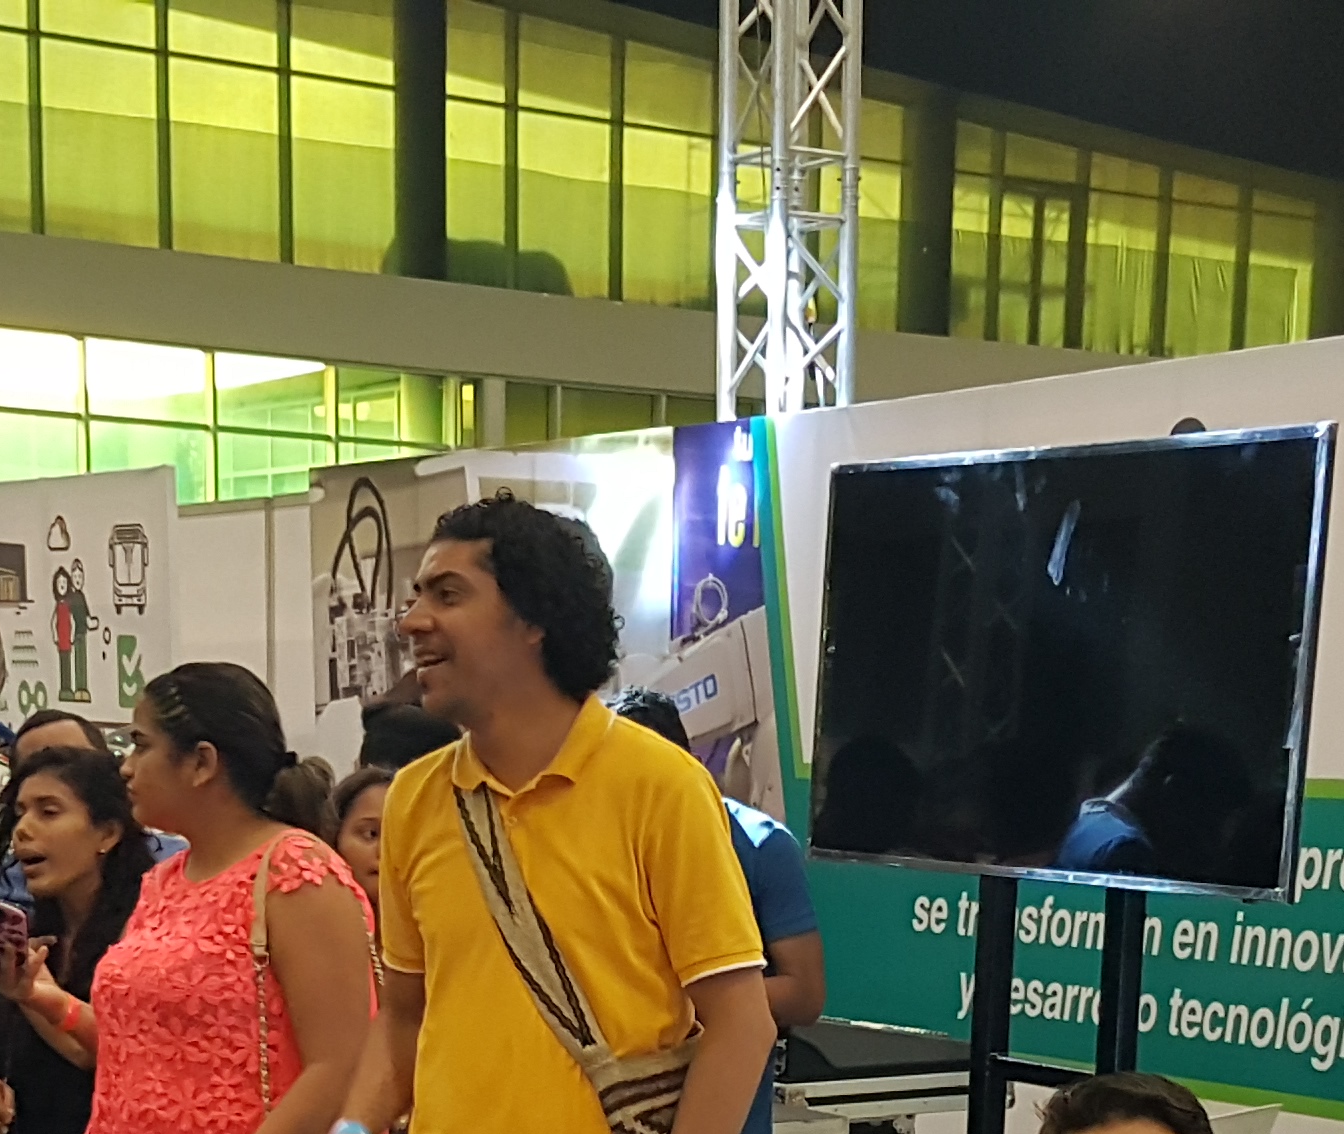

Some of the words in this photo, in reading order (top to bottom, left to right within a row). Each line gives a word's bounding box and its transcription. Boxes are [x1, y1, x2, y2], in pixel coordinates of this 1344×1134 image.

[676, 673, 718, 712] STO
[912, 895, 948, 933] se
[1172, 918, 1218, 962] en
[1010, 977, 1157, 1032] esarro
